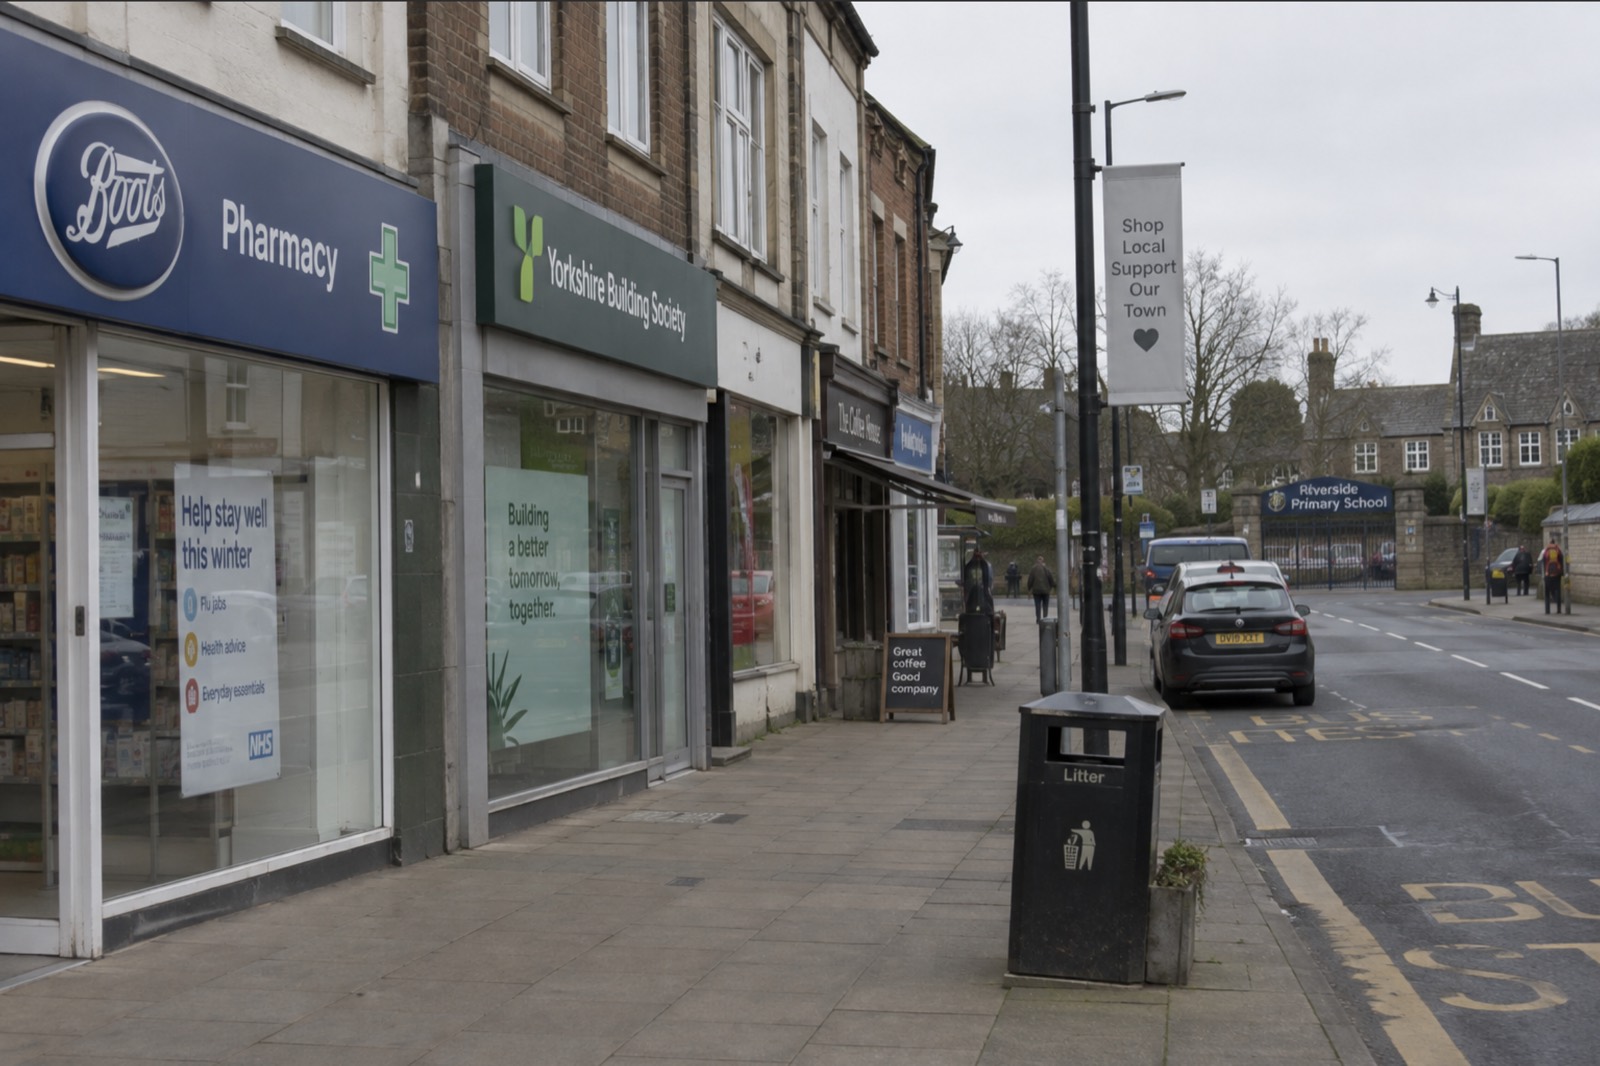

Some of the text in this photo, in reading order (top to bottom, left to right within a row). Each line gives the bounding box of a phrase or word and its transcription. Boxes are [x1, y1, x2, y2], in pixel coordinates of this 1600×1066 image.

[66, 141, 166, 249] Boots
[1122, 217, 1164, 235] Shop
[222, 198, 338, 292] Pharmacy
[1122, 238, 1165, 254] Local
[1111, 259, 1177, 279] Support
[547, 246, 686, 343] Yorkshire Building Society
[1129, 282, 1160, 297] Our
[1123, 303, 1166, 318] Town
[1300, 483, 1358, 496] Riverside
[1291, 496, 1387, 512] Primary School
[181, 494, 268, 536] Help stay well
[508, 502, 549, 533] Building
[182, 537, 252, 570] this winter
[508, 533, 549, 558] a better
[508, 567, 561, 591] tomorrow,
[200, 596, 227, 615] Flu jabs
[509, 596, 556, 626] together.
[201, 638, 246, 656] Health advice
[892, 646, 923, 657] Great
[892, 658, 927, 669] coffee
[892, 671, 921, 682] Good
[202, 680, 265, 704] Everyday essentials
[891, 684, 939, 696] company
[249, 732, 273, 757] NHS
[1063, 768, 1105, 784] Litter
